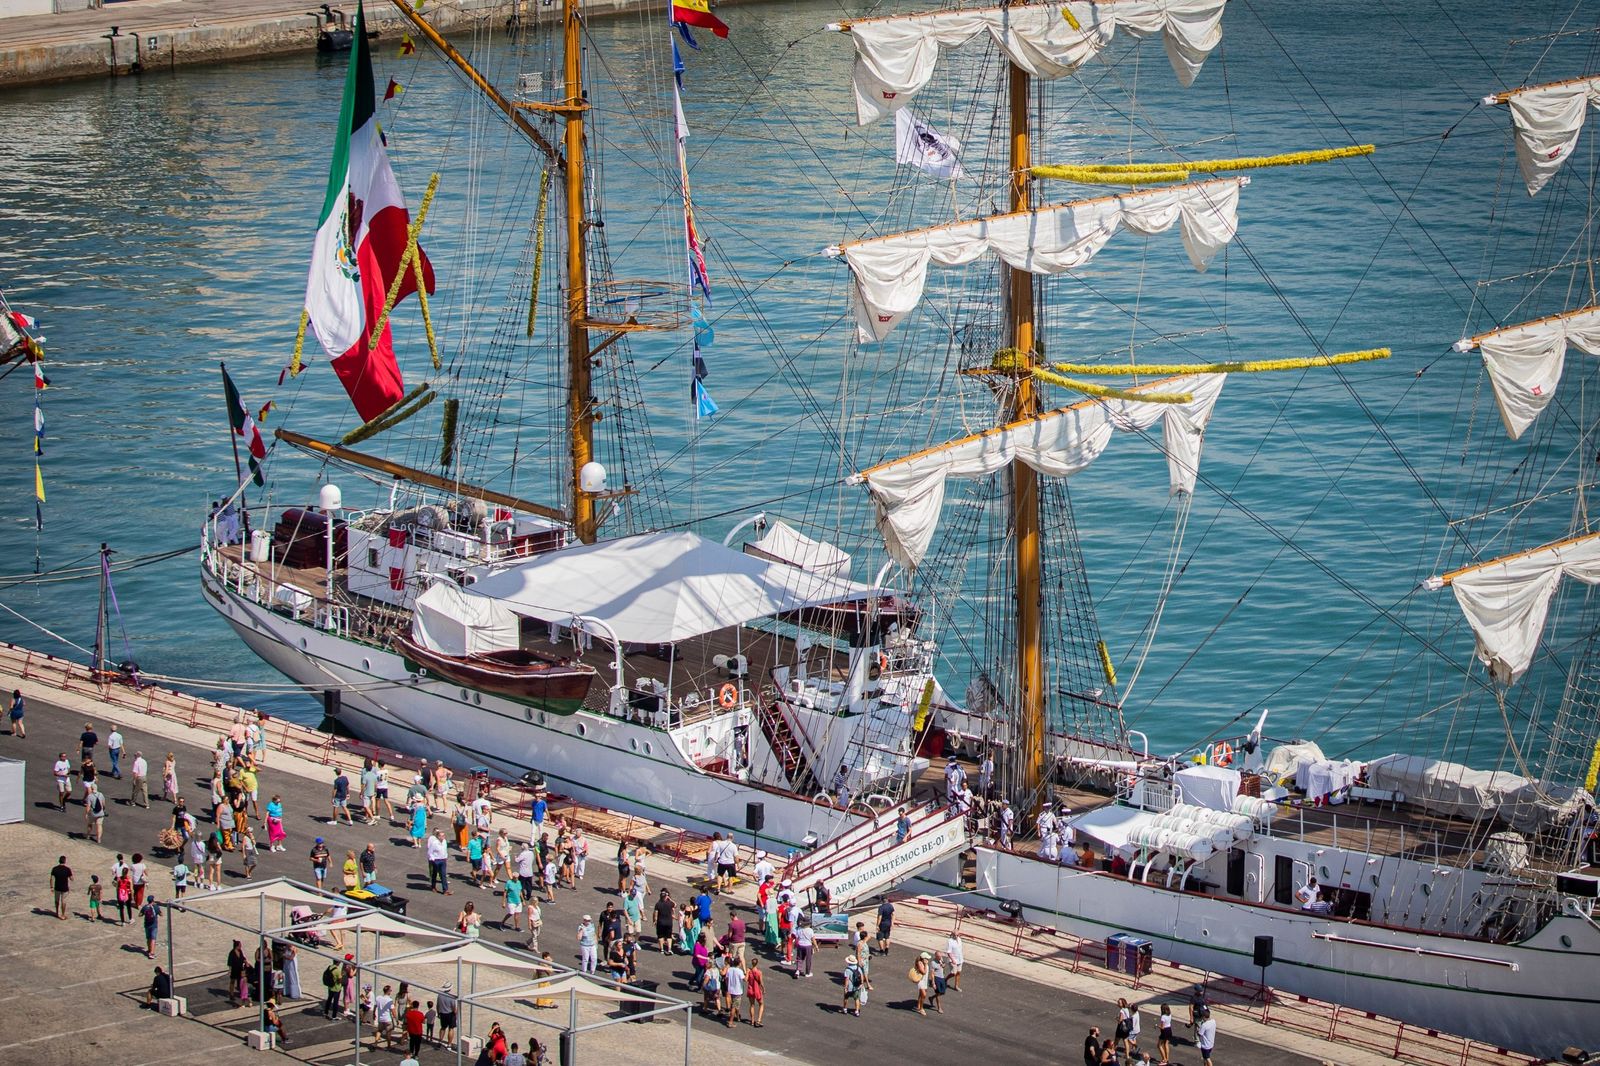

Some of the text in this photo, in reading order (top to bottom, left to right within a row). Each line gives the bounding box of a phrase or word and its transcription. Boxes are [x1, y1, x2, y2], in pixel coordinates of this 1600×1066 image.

[835, 835, 944, 895] ARM CUAUHTÉMOC BE-01
